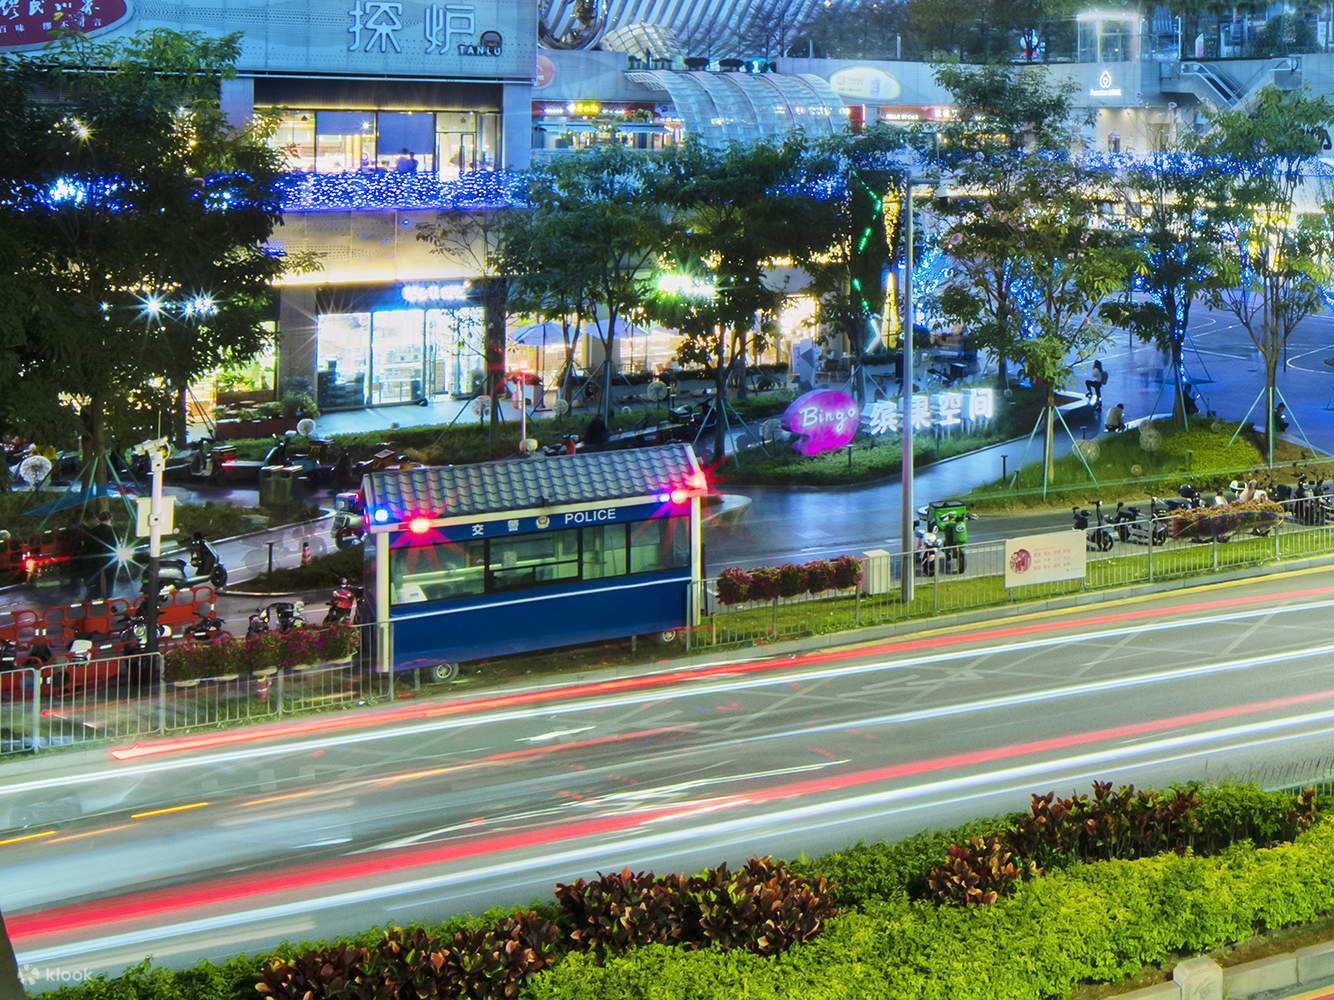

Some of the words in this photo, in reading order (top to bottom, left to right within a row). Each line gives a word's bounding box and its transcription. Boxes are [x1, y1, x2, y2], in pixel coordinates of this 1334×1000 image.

[348, 0, 475, 55] 探炉
[457, 44, 502, 56] TANLU
[799, 406, 857, 433] Bingo
[869, 388, 994, 436] 缤果空间
[564, 508, 617, 525] POLICE
[471, 519, 520, 537] 交警
